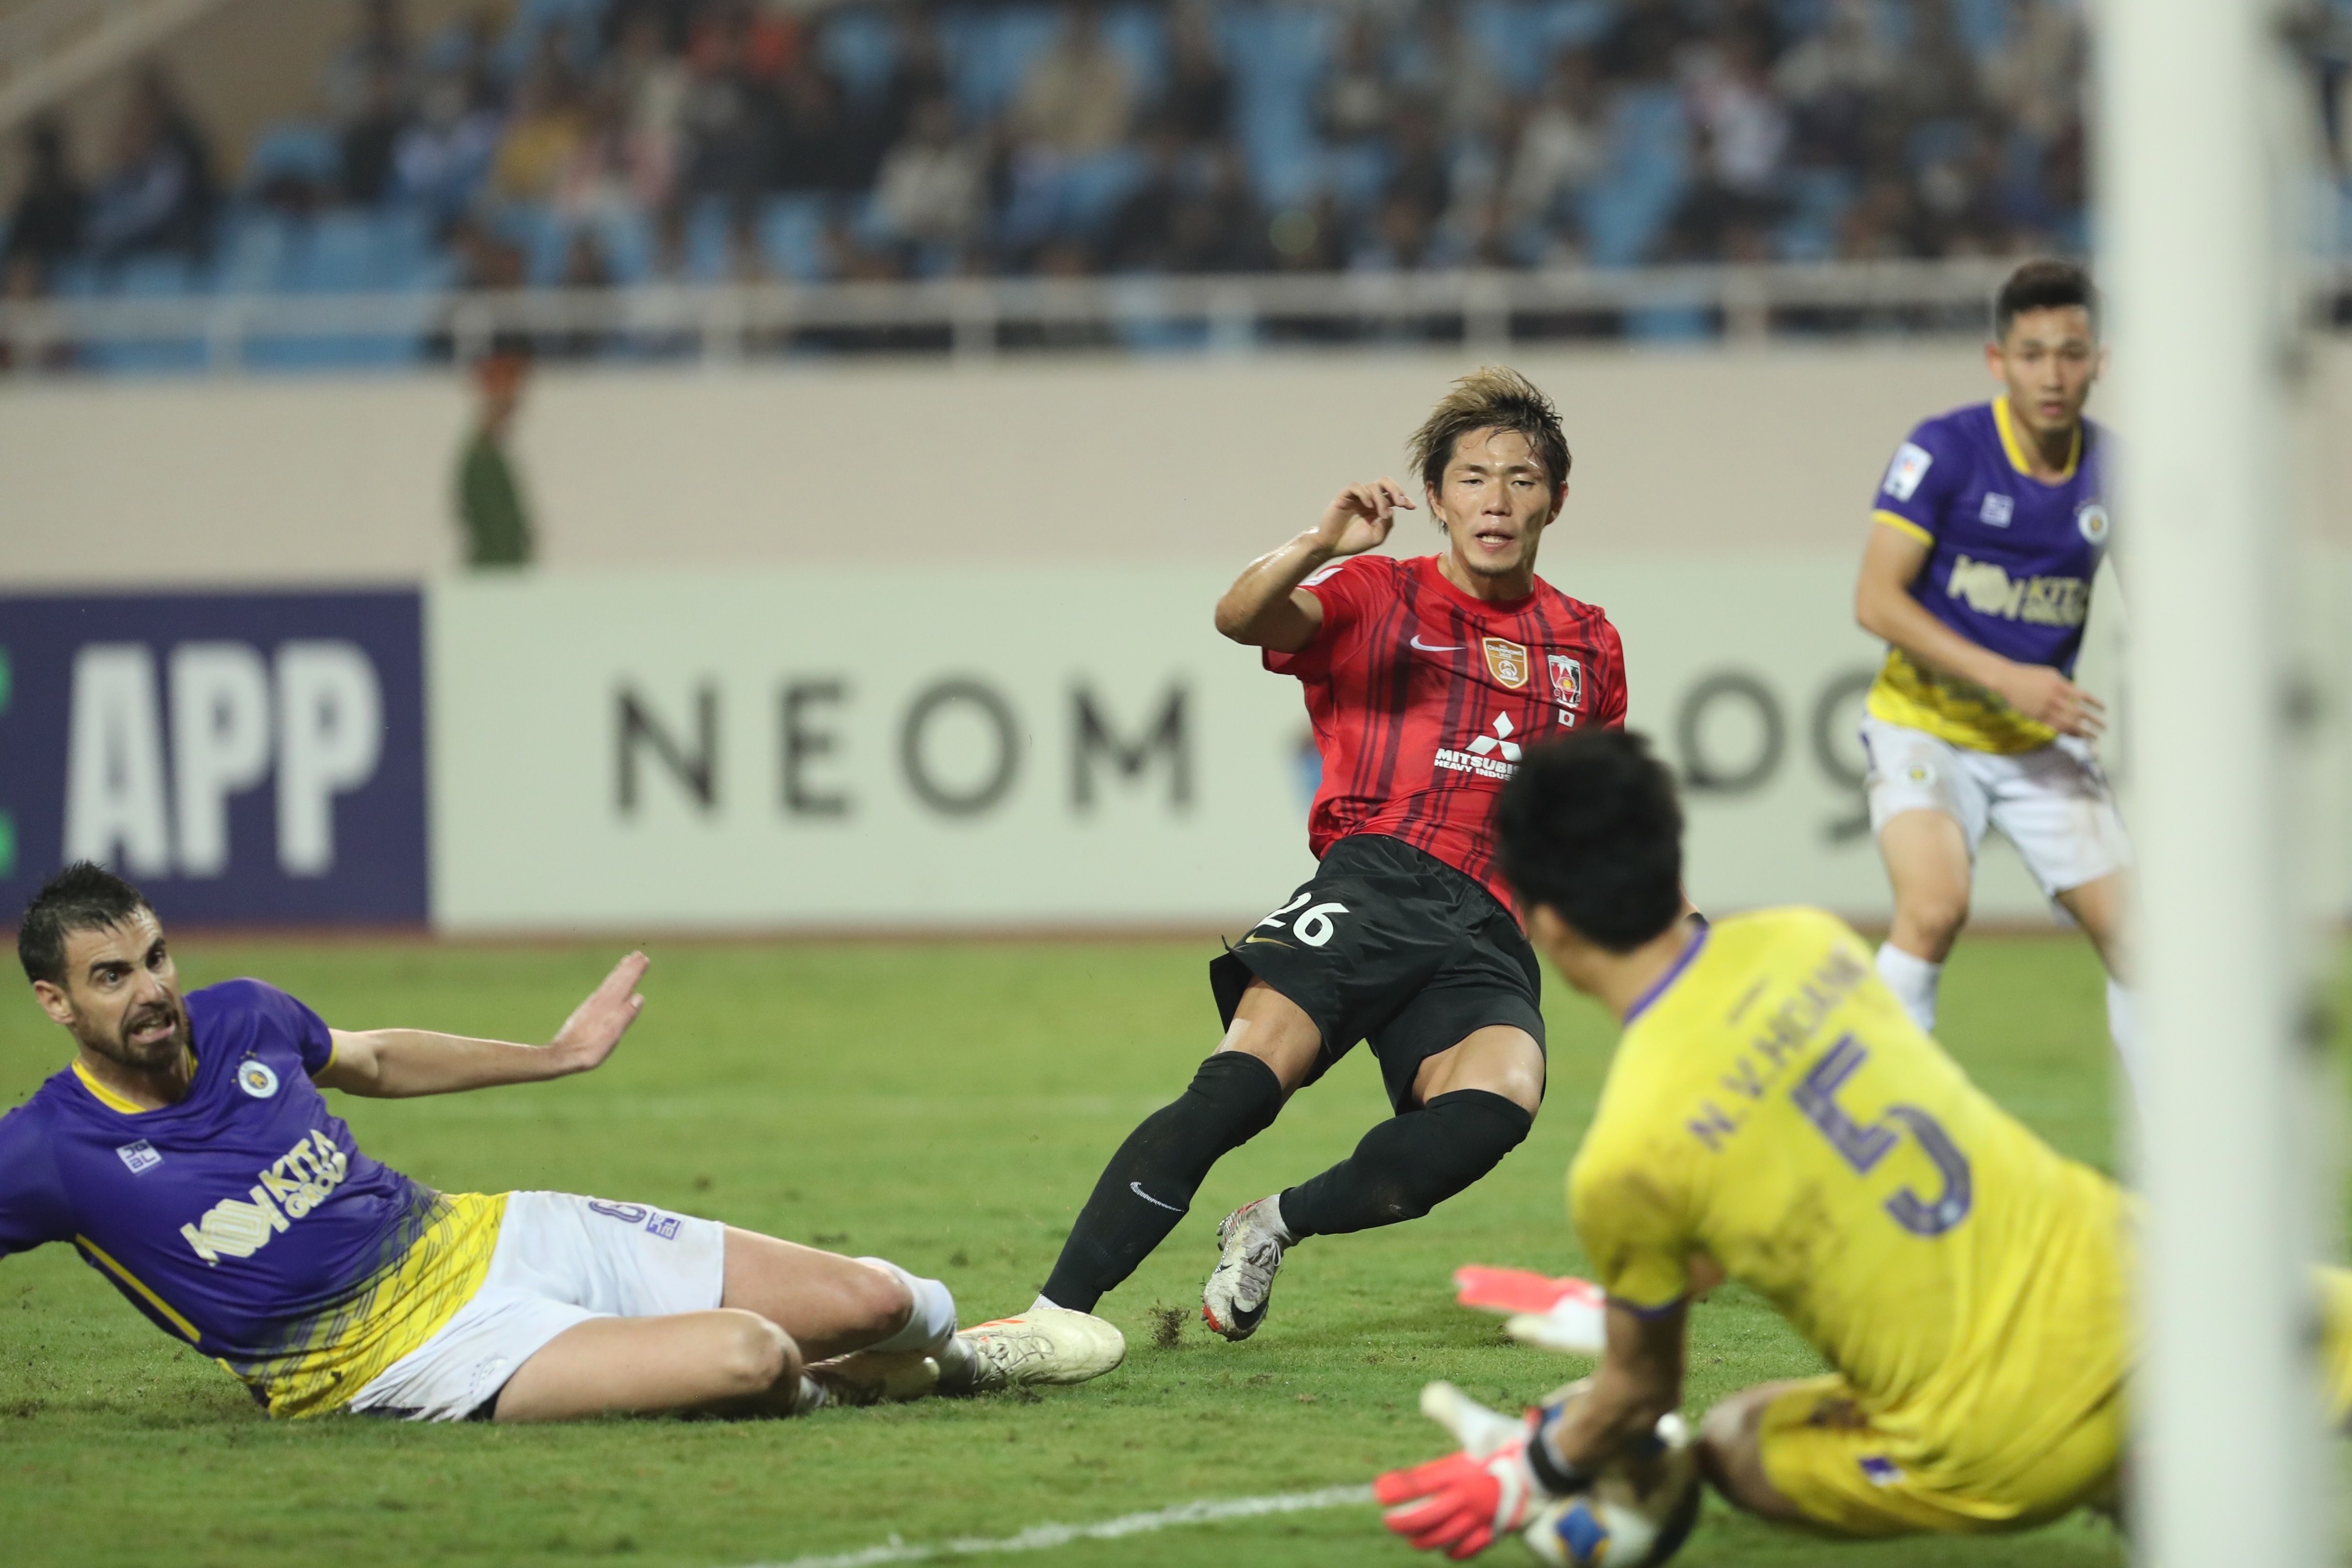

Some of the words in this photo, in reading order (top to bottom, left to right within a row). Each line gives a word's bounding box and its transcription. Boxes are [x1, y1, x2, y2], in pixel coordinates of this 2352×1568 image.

[62, 639, 384, 879] APP
[612, 673, 1197, 822] NEOM
[1434, 759, 1473, 772] HEAVY
[1475, 768, 1514, 781] INDUS
[1254, 892, 1350, 947] 26
[258, 1129, 338, 1203] KITA
[1790, 1031, 1972, 1236] 5
